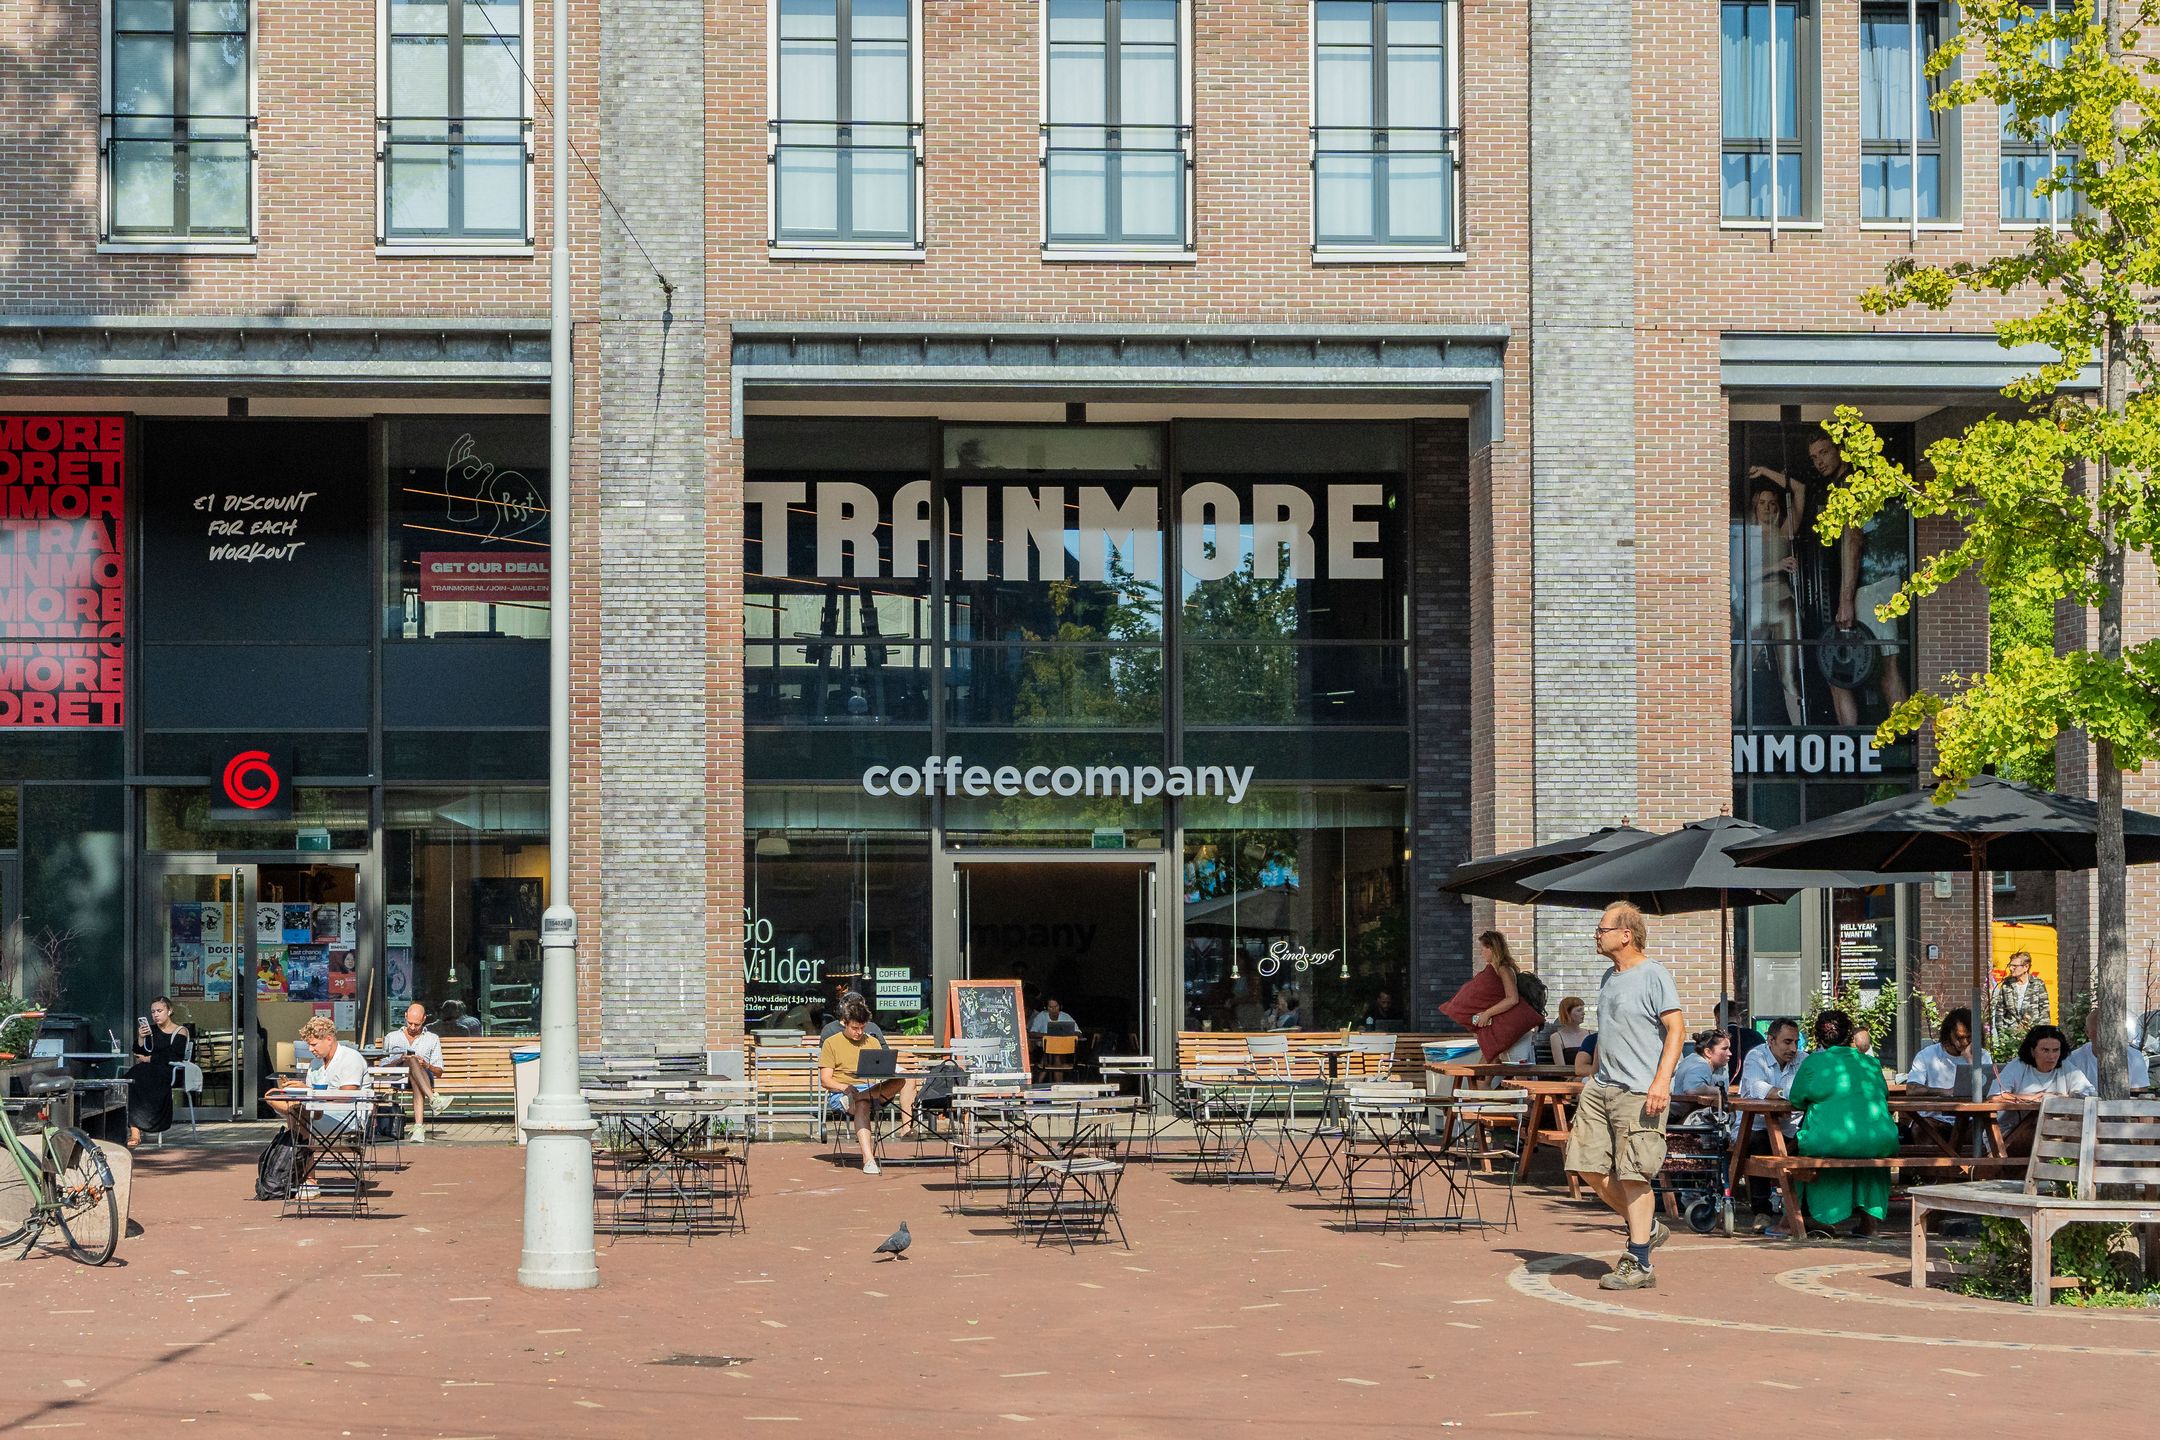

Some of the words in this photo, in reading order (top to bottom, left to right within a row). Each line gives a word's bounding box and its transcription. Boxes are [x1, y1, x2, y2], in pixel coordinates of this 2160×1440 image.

[0, 485, 121, 519] MOR
[193, 493, 216, 512] €1
[223, 491, 318, 512] DISCOUNT
[502, 492, 534, 522] Psst
[208, 520, 245, 536] FOR
[250, 519, 298, 536] EACH
[744, 481, 1384, 581] TRAINMORE
[209, 542, 306, 562] WORKOUT
[431, 562, 464, 573] GET
[467, 562, 502, 573] OUR
[505, 562, 549, 573] DEAL
[1733, 735, 1882, 773] NMORE
[862, 756, 1254, 804] coffeecompany
[1840, 923, 1857, 931] HELL
[1857, 923, 1878, 931] YEAH,
[207, 946, 244, 954] DOCS
[1257, 940, 1310, 977] Sinds
[1309, 948, 1341, 965] 1996
[878, 970, 907, 978] COFFEE
[744, 1003, 767, 1011] ilder
[770, 1003, 788, 1011] Land
